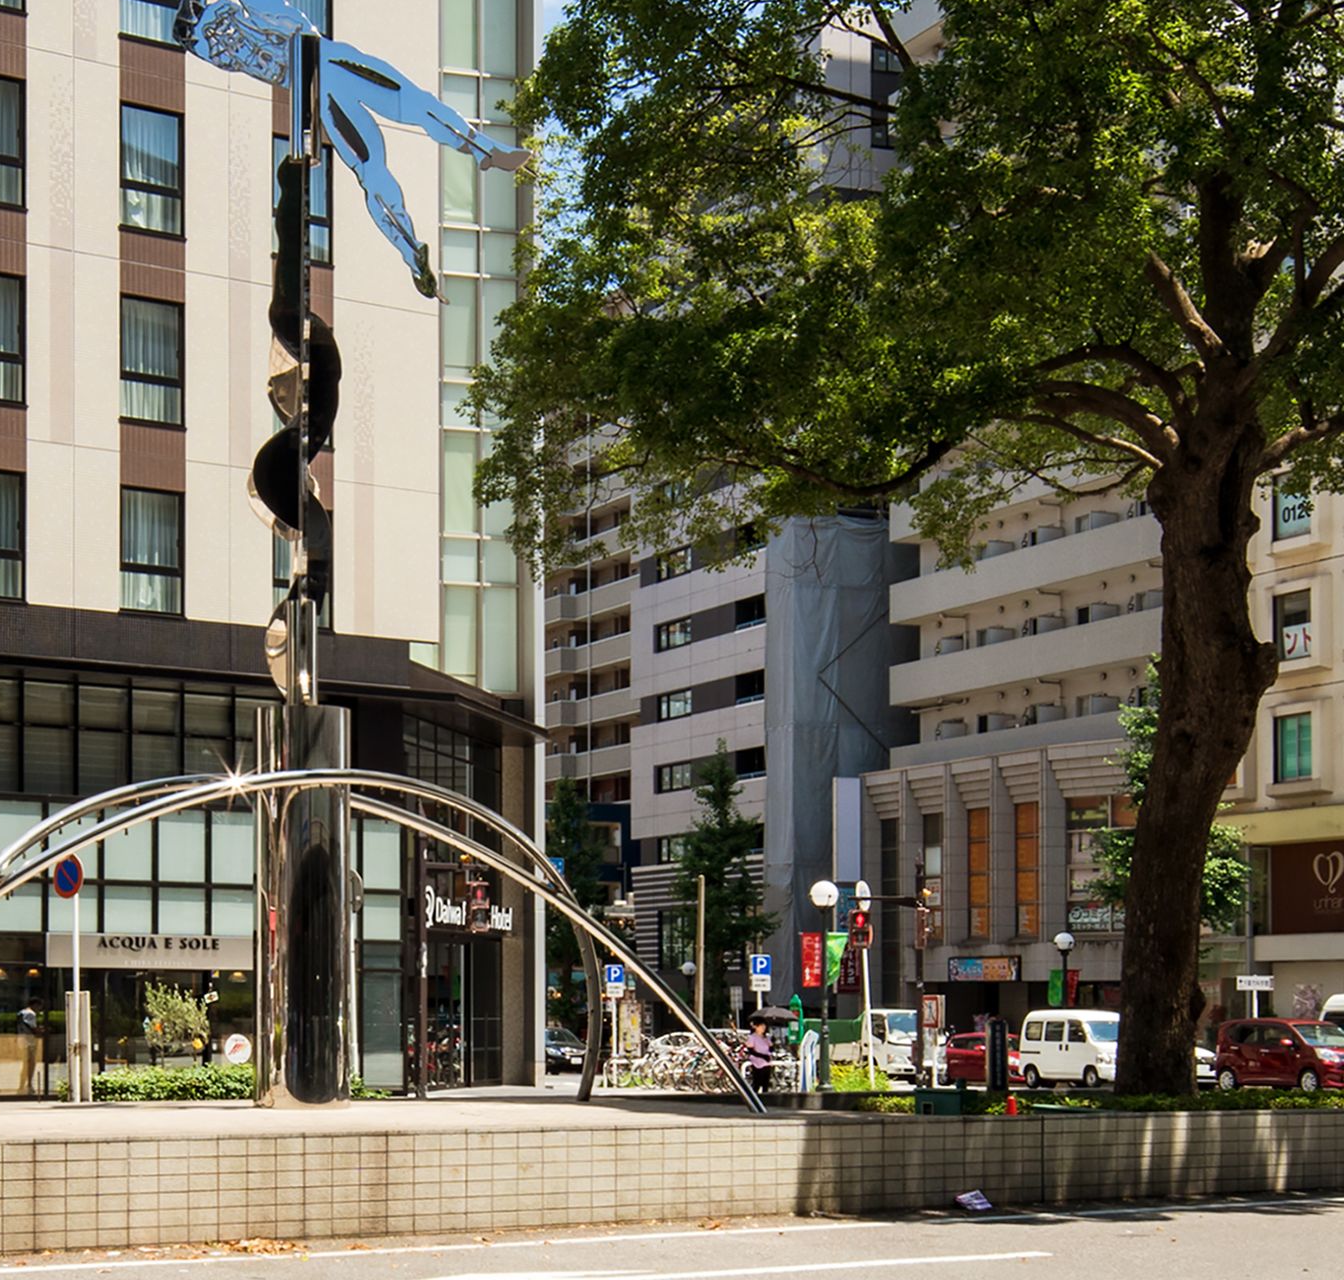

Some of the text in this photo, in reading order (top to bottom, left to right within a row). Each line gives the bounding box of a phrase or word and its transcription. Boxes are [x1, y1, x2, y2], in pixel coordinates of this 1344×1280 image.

[435, 896, 462, 926] Daiwa
[490, 904, 513, 931] Hotel
[97, 936, 220, 952] ACQUA E SOLE
[756, 957, 767, 973] P
[610, 967, 621, 981] P
